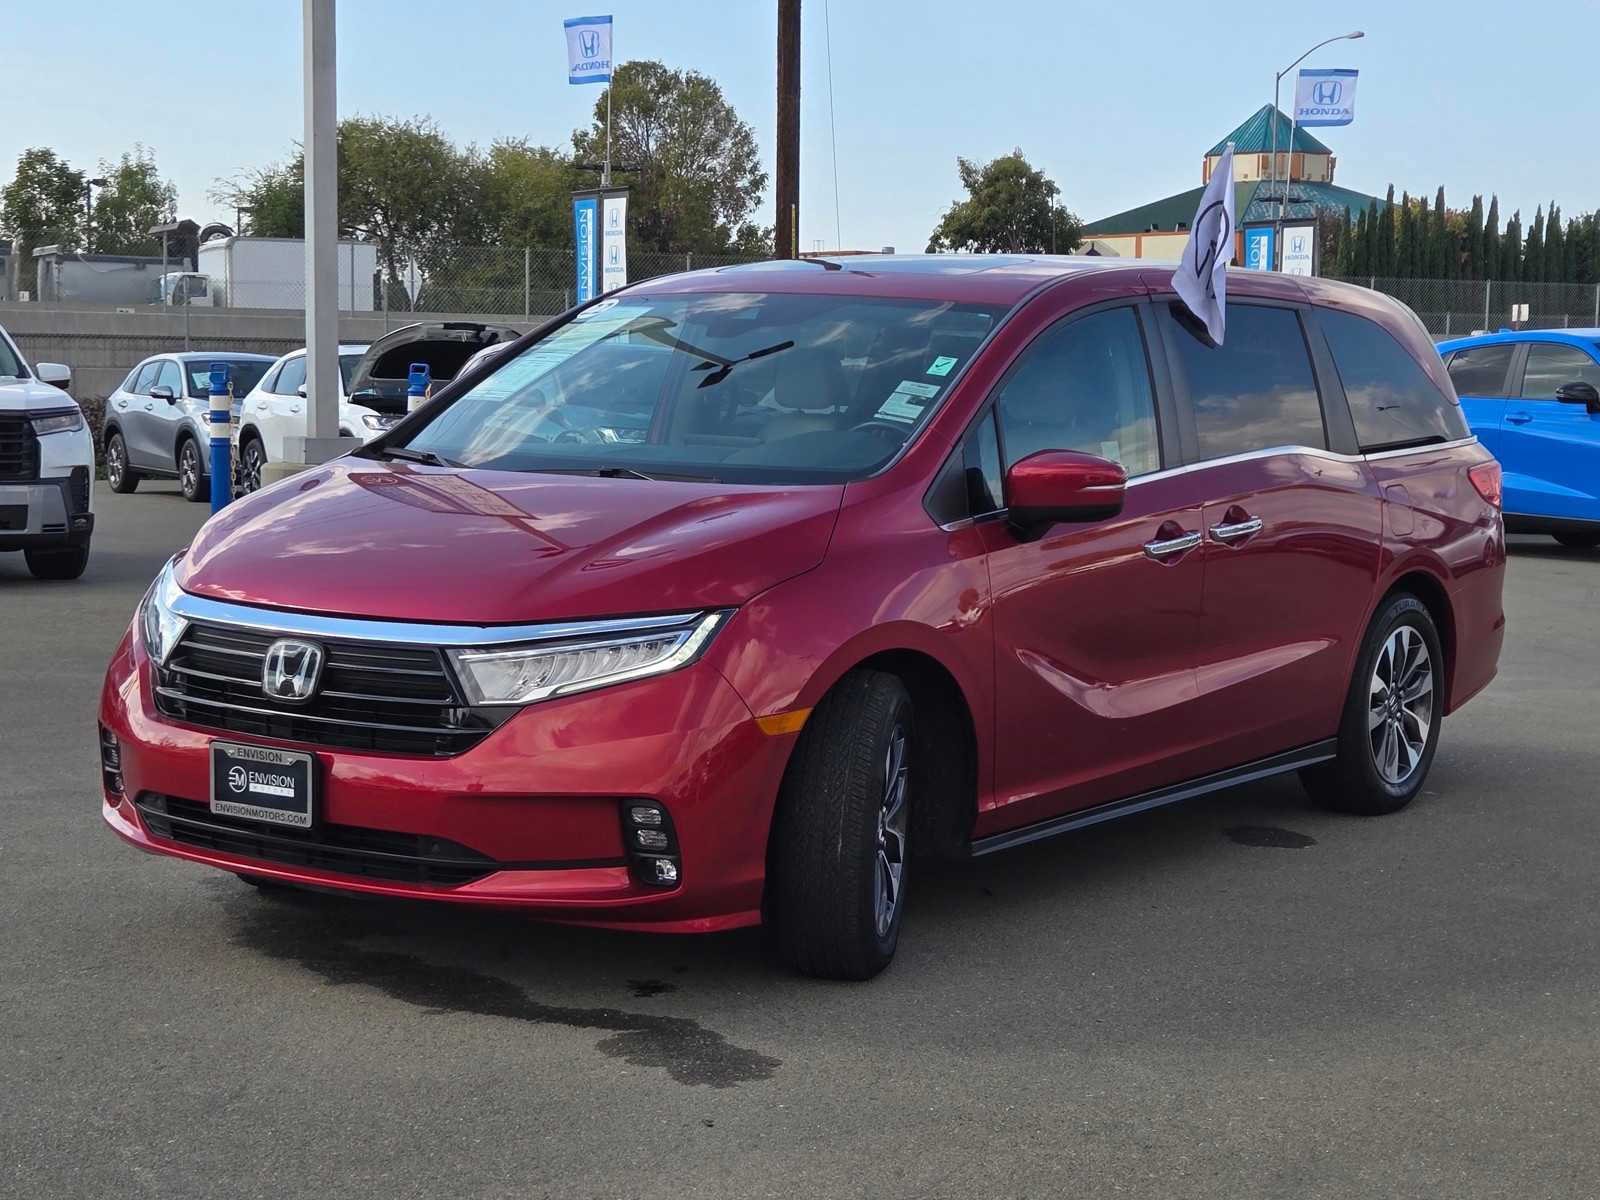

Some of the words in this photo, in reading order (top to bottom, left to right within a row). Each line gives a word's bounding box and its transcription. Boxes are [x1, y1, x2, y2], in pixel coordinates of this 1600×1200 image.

[579, 209, 588, 302] ENVISION
[237, 748, 282, 762] ENVISION
[249, 771, 295, 788] ENVISION
[215, 803, 307, 825] ENVISIONMOTORS.COM
